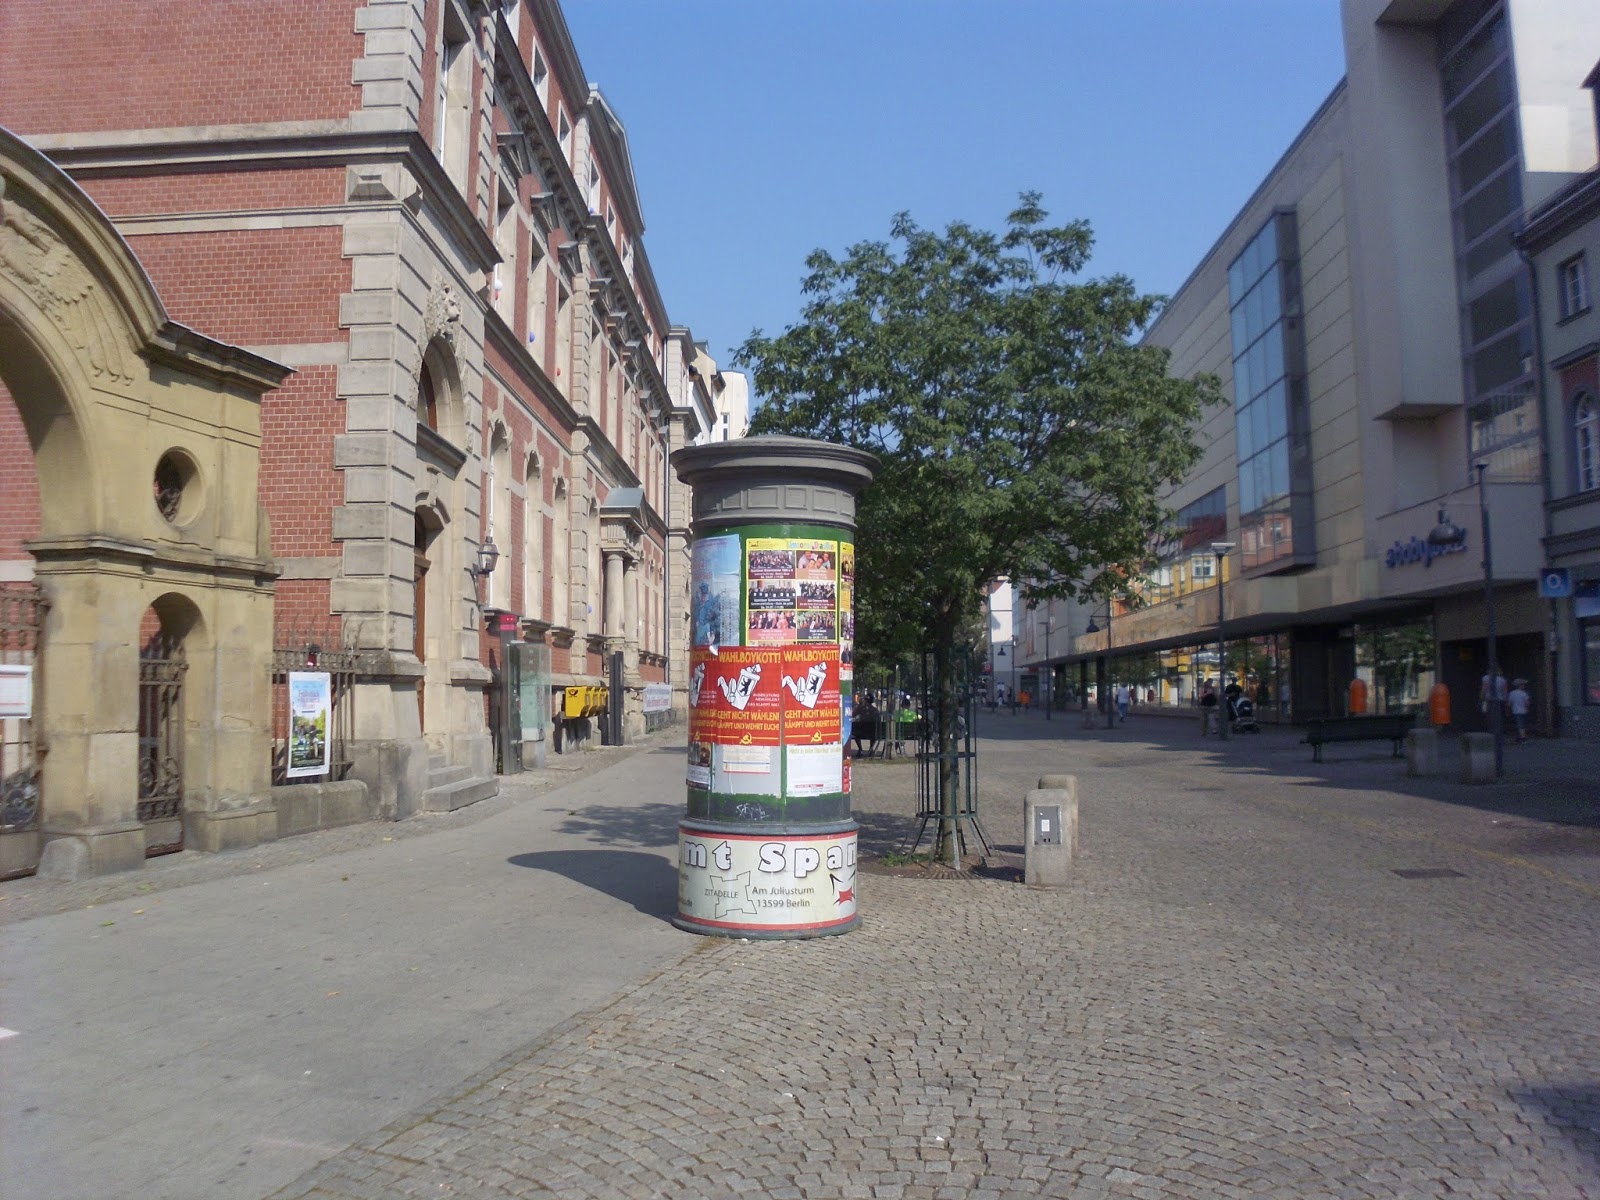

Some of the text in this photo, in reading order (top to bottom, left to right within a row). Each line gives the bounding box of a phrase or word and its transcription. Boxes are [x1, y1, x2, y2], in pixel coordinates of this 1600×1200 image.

[720, 651, 780, 663] WAHLBOYKOTT!
[718, 710, 732, 719] GEHT
[732, 710, 750, 720] NICHT
[751, 710, 780, 721] WÄHLEN!
[784, 710, 801, 718] GEHT
[802, 710, 820, 718] NICHT
[784, 720, 804, 728] KÄMPFT
[683, 840, 732, 870] mt
[704, 888, 738, 898] ZITADELLE
[752, 886, 814, 896] Am Juliusturm
[757, 900, 810, 908] 13599 Berlin
